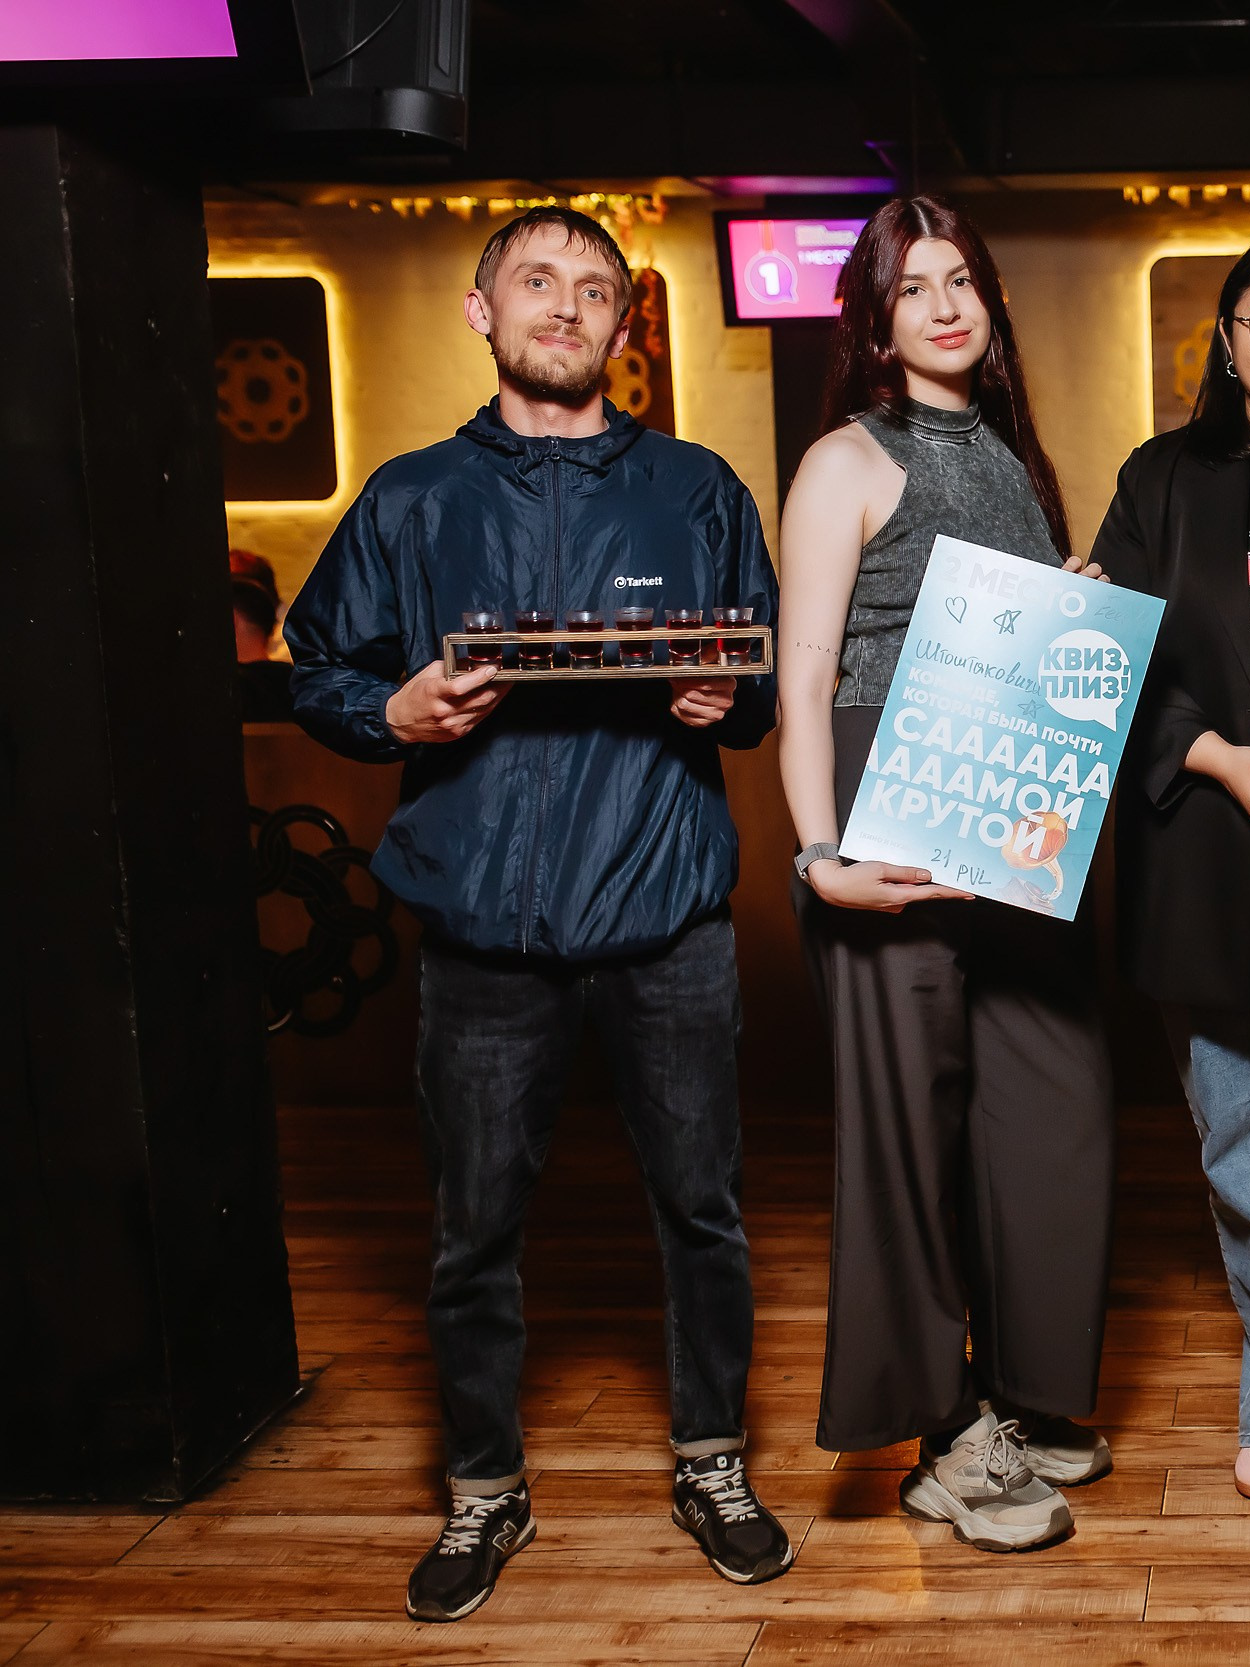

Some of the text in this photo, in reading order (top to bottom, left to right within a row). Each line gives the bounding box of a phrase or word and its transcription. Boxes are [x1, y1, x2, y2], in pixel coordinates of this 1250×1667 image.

[758, 262, 781, 296] 1
[626, 575, 664, 588] Tarkett
[943, 555, 962, 583] 2
[967, 562, 1087, 618] МЕСТО
[893, 707, 1111, 801] СААААА
[901, 685, 1104, 757] КОТОРАЯ БЫЛА ПОЧТИ
[868, 778, 1049, 860] КРУТОЙ
